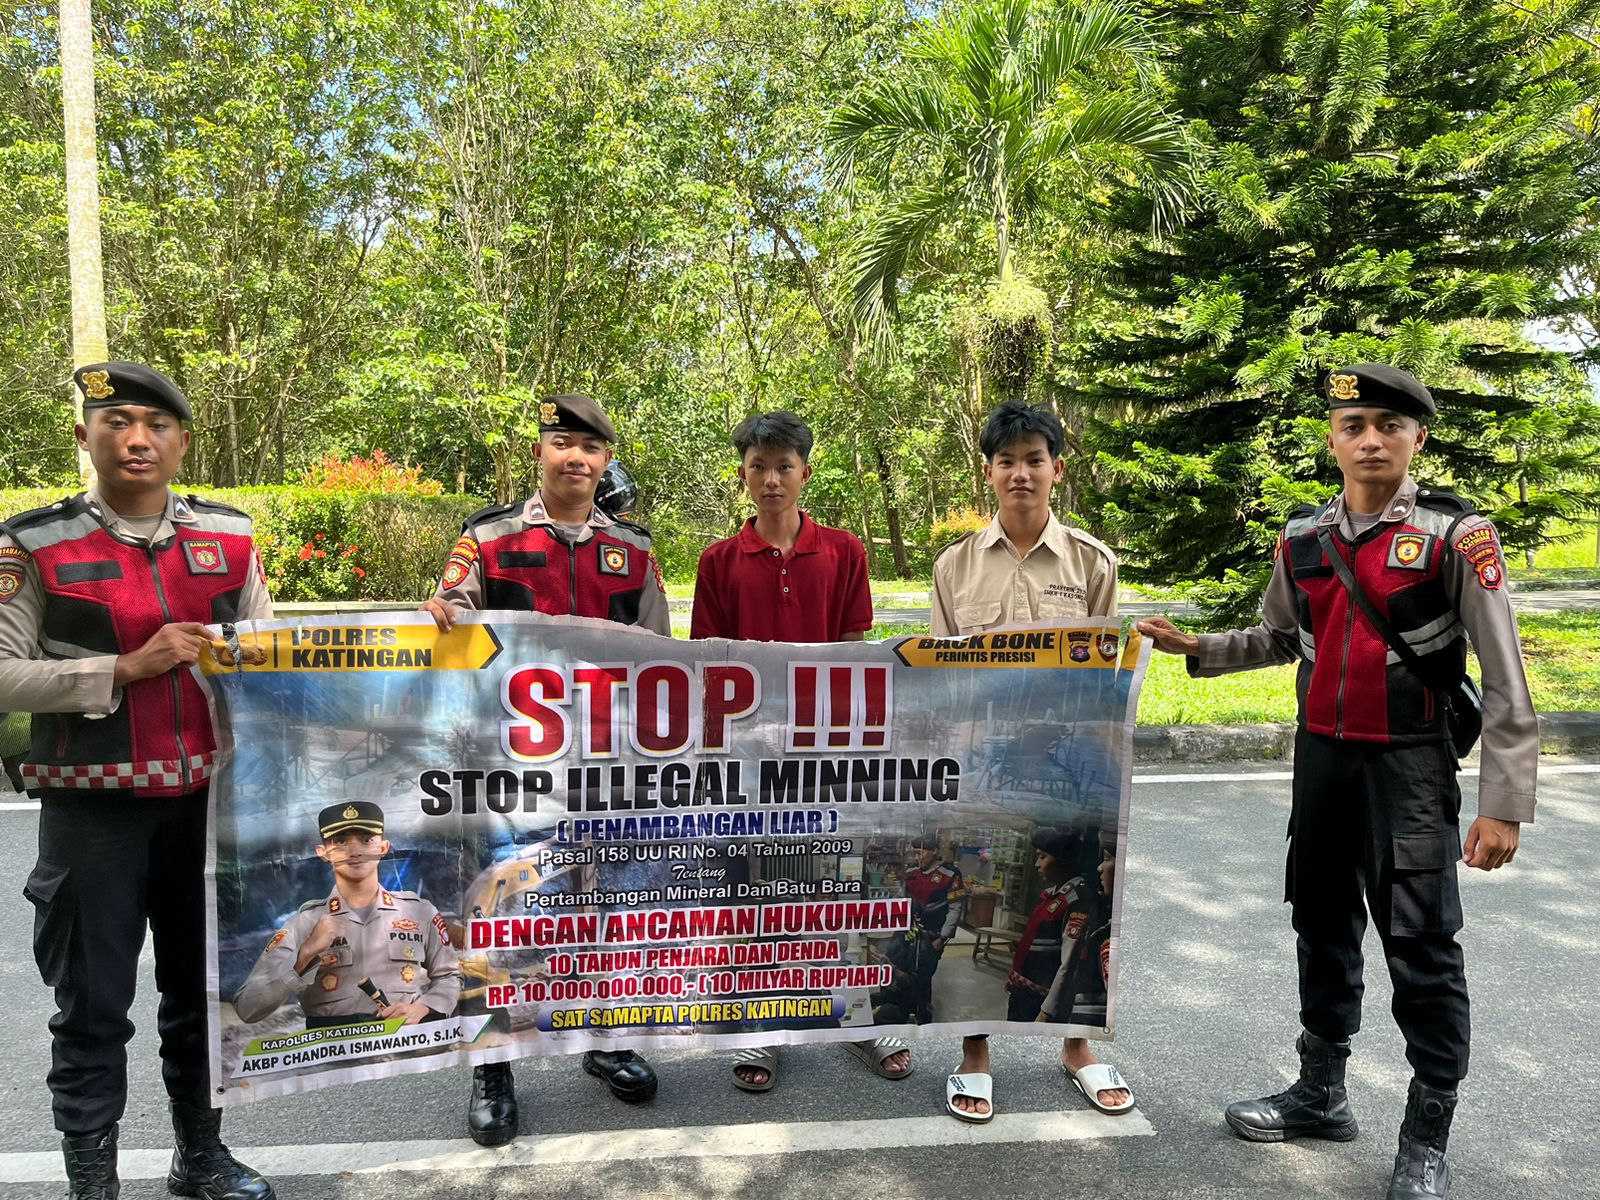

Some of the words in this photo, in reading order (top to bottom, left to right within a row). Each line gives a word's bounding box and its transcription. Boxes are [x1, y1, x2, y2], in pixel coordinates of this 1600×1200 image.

[1457, 529, 1491, 549] POLRES
[292, 628, 397, 646] POLRES
[991, 633, 1056, 649] BONE
[292, 649, 432, 667] KATINGAN
[935, 651, 988, 663] PERINTIS
[990, 651, 1036, 662] PRESISI
[503, 662, 760, 761] STOP
[788, 663, 892, 751] !!!
[420, 768, 553, 815] STOP
[567, 761, 747, 813] ILLEGAL
[758, 757, 961, 805] MINNING
[574, 812, 766, 841] PENAMBANGAN
[772, 811, 823, 835] LIAR
[540, 848, 592, 865] Pasal
[598, 846, 629, 862] 158
[636, 844, 663, 861] UU
[668, 843, 688, 860] RI
[693, 842, 721, 859] No.
[727, 841, 748, 857] 04
[754, 840, 806, 857] Tahun
[812, 839, 852, 856] 2009
[671, 864, 728, 881] Tentang
[526, 887, 660, 907] Pertambangan
[667, 883, 731, 901] Mineral
[737, 881, 773, 898] Dan
[776, 879, 816, 896] Batu
[821, 878, 861, 895] Bara
[390, 931, 423, 943] POLRI
[470, 914, 597, 949] DENGAN
[605, 906, 755, 944] ANCAMAN
[762, 900, 911, 935] HUKUMAN
[547, 953, 572, 975] 10
[576, 950, 641, 973] TAHUN
[647, 945, 730, 968] PENJARA
[734, 943, 775, 965] DAN
[778, 940, 839, 963] DENDA
[487, 984, 518, 1006] RP.
[521, 976, 696, 1004] 10.000.000.000,-
[710, 973, 732, 993] 10
[737, 968, 805, 991] MILYAR
[809, 966, 878, 988] RUPIAH
[552, 1009, 585, 1028] SAT
[589, 1006, 673, 1026] SAMAPTA
[678, 1004, 743, 1023] POLRES
[746, 999, 833, 1020] KATINGAN
[262, 1031, 324, 1050] KAPOLRES
[325, 1024, 385, 1039] KATINGAN
[242, 1056, 279, 1074] AKBP
[282, 1044, 346, 1067] CHANDRA
[349, 1034, 430, 1054] ISMAWANTO,
[434, 1028, 464, 1042] S.I.K.
